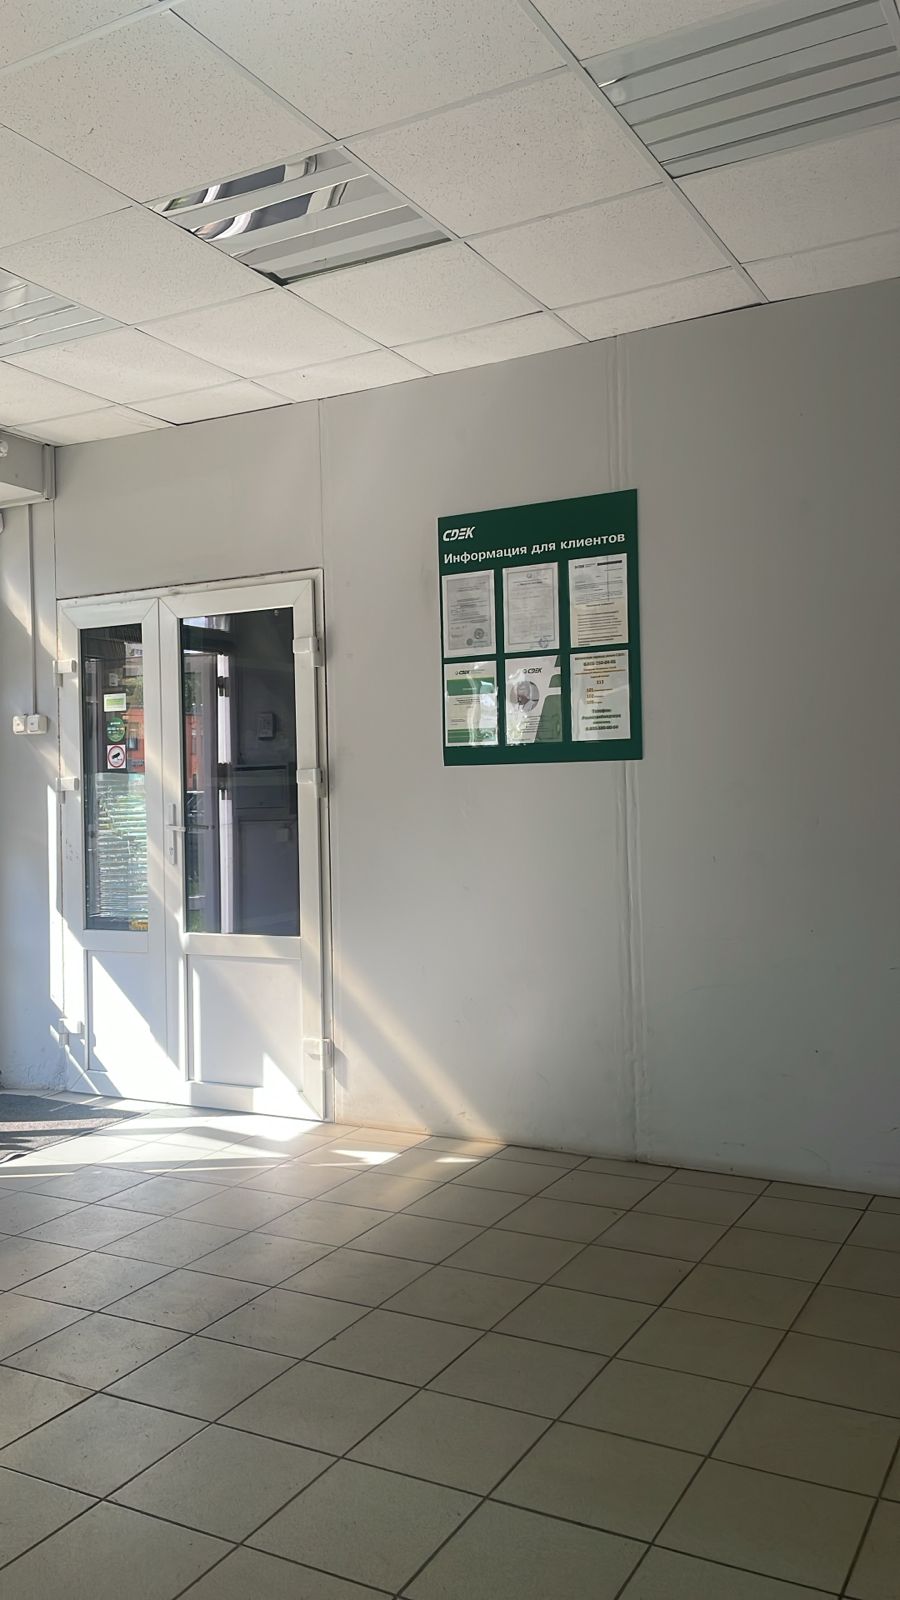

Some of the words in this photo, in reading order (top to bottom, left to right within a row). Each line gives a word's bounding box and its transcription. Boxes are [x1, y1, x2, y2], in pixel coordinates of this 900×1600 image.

[442, 526, 475, 542] CDEK
[444, 546, 527, 564] Информация
[531, 541, 556, 555] для
[560, 533, 626, 550] клиентов
